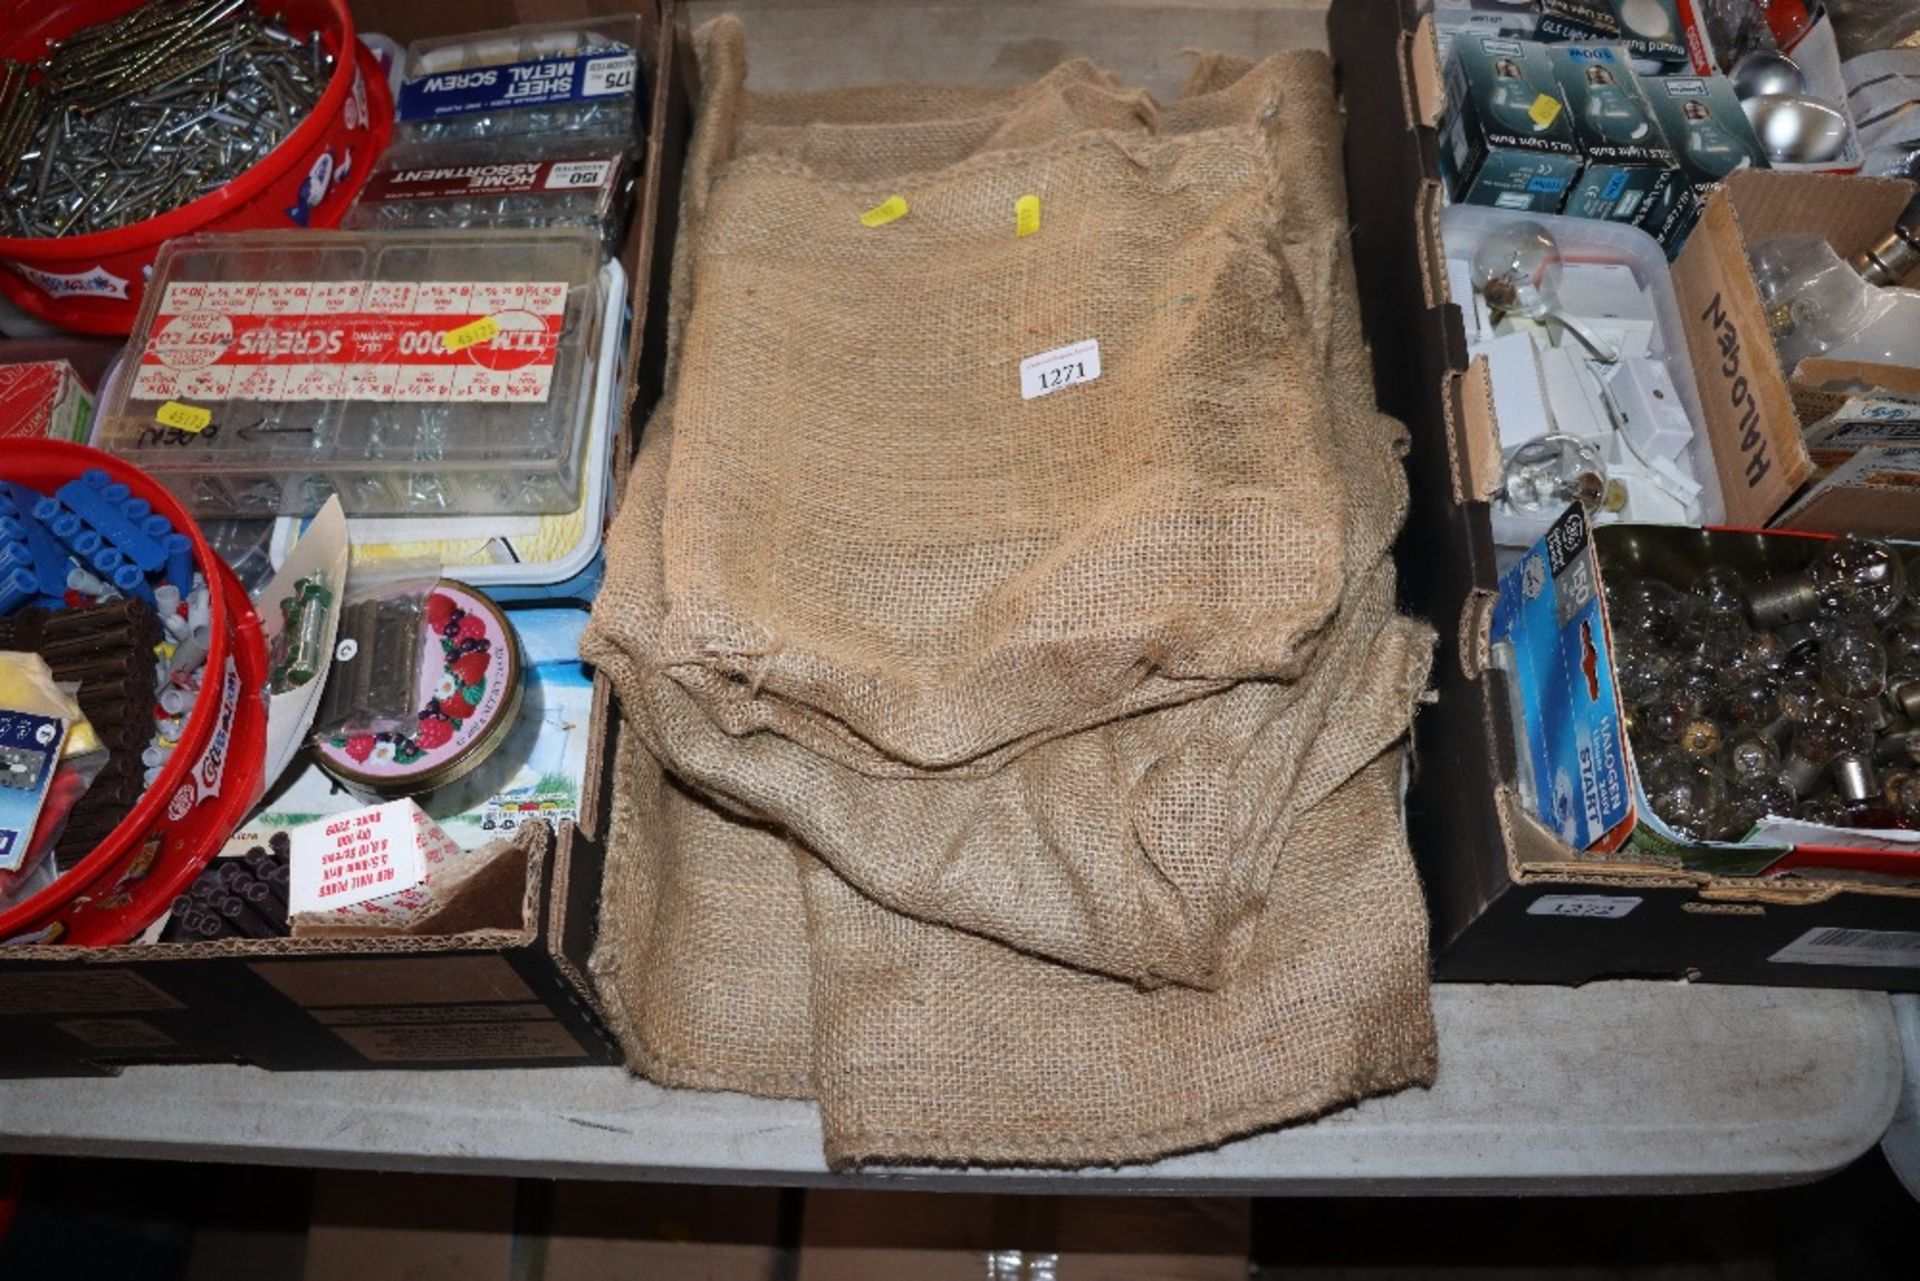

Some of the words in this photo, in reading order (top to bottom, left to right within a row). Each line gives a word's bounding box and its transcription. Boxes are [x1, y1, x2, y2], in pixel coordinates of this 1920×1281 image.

[423, 69, 499, 93] SCREW
[507, 59, 576, 81] METAL
[605, 69, 632, 89] 175
[503, 76, 573, 98] SHEET
[389, 162, 543, 184] ASSORTMENT
[466, 173, 537, 188] HOME
[569, 171, 600, 185] 150
[236, 330, 344, 355] SCREWS
[399, 330, 448, 355] 000
[1039, 362, 1087, 391] 1271
[1572, 560, 1590, 606] 150
[1600, 715, 1622, 810] HALOGEN
[1579, 747, 1600, 825] START
[318, 879, 348, 898] PLUGS
[351, 872, 374, 890] WALL
